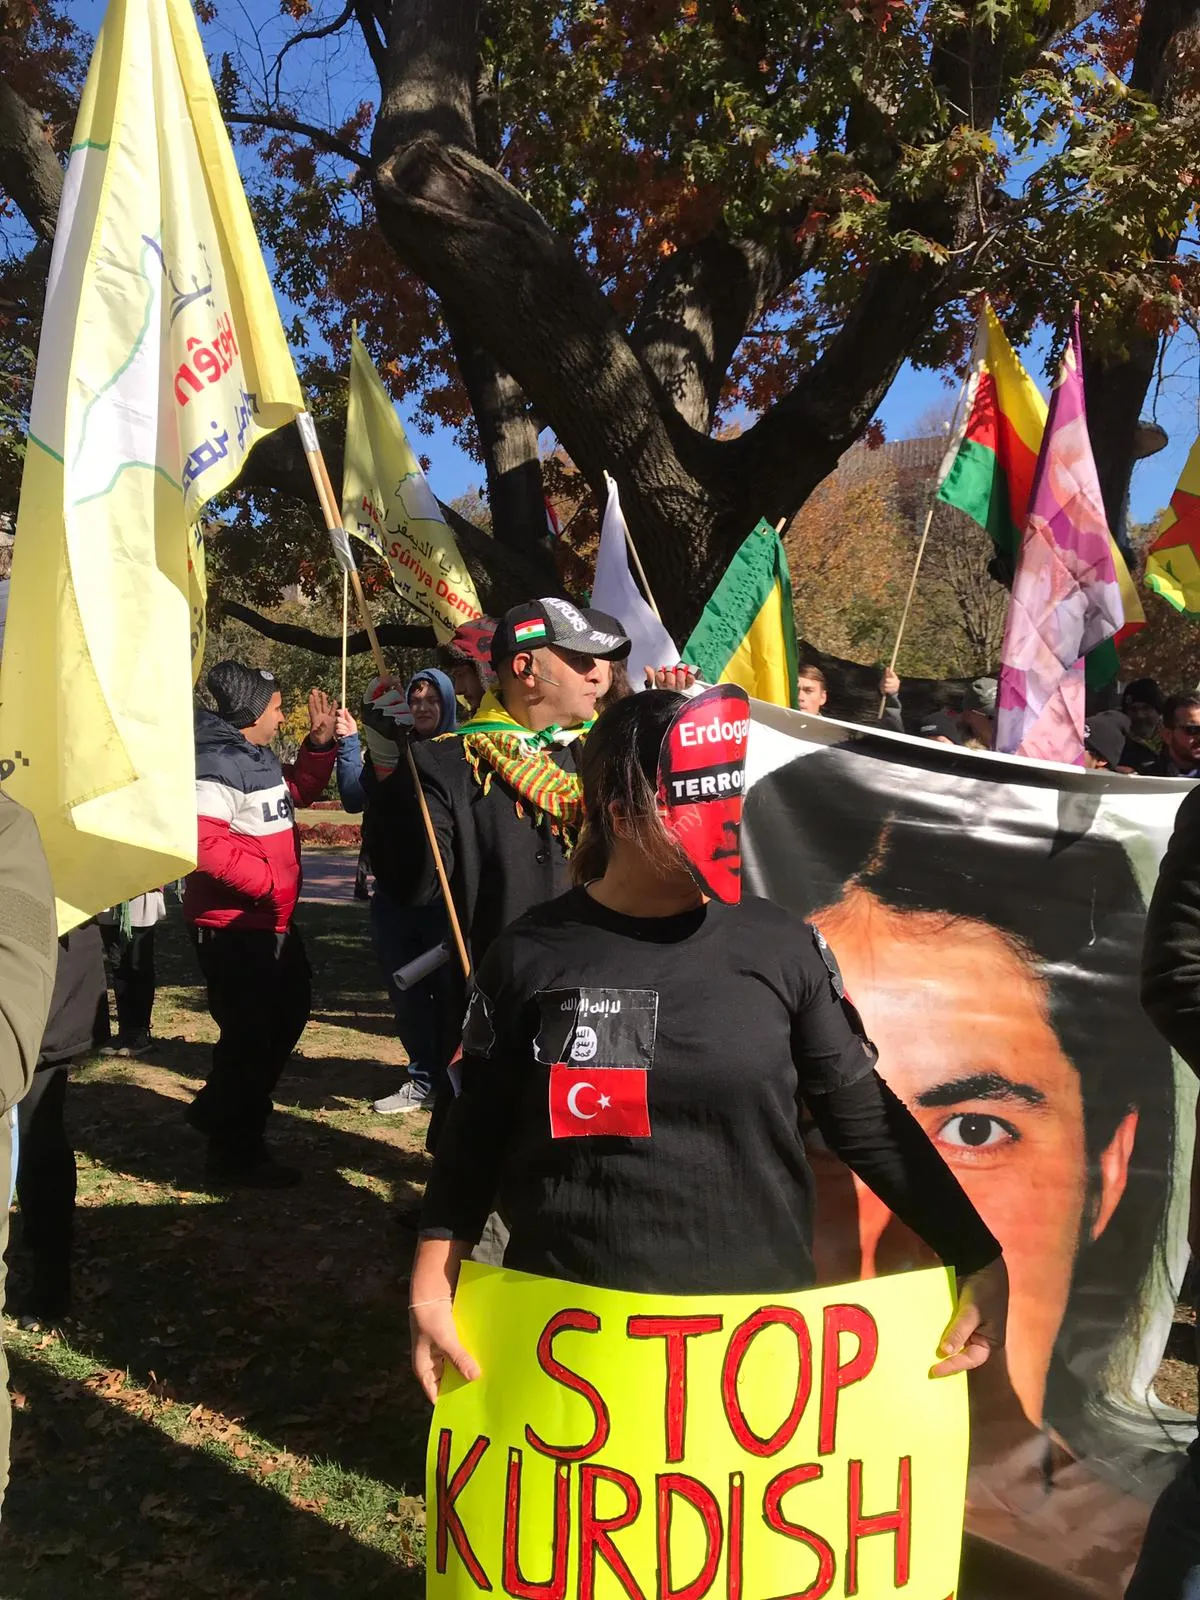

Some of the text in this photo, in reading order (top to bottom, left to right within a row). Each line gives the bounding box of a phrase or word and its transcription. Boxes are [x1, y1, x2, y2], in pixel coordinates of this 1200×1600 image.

[388, 542, 433, 588] Sûriya
[589, 630, 619, 648] TAN
[679, 717, 750, 746] Erdoga
[525, 1302, 879, 1463] STOP
[436, 1428, 912, 1600] KURDISH
